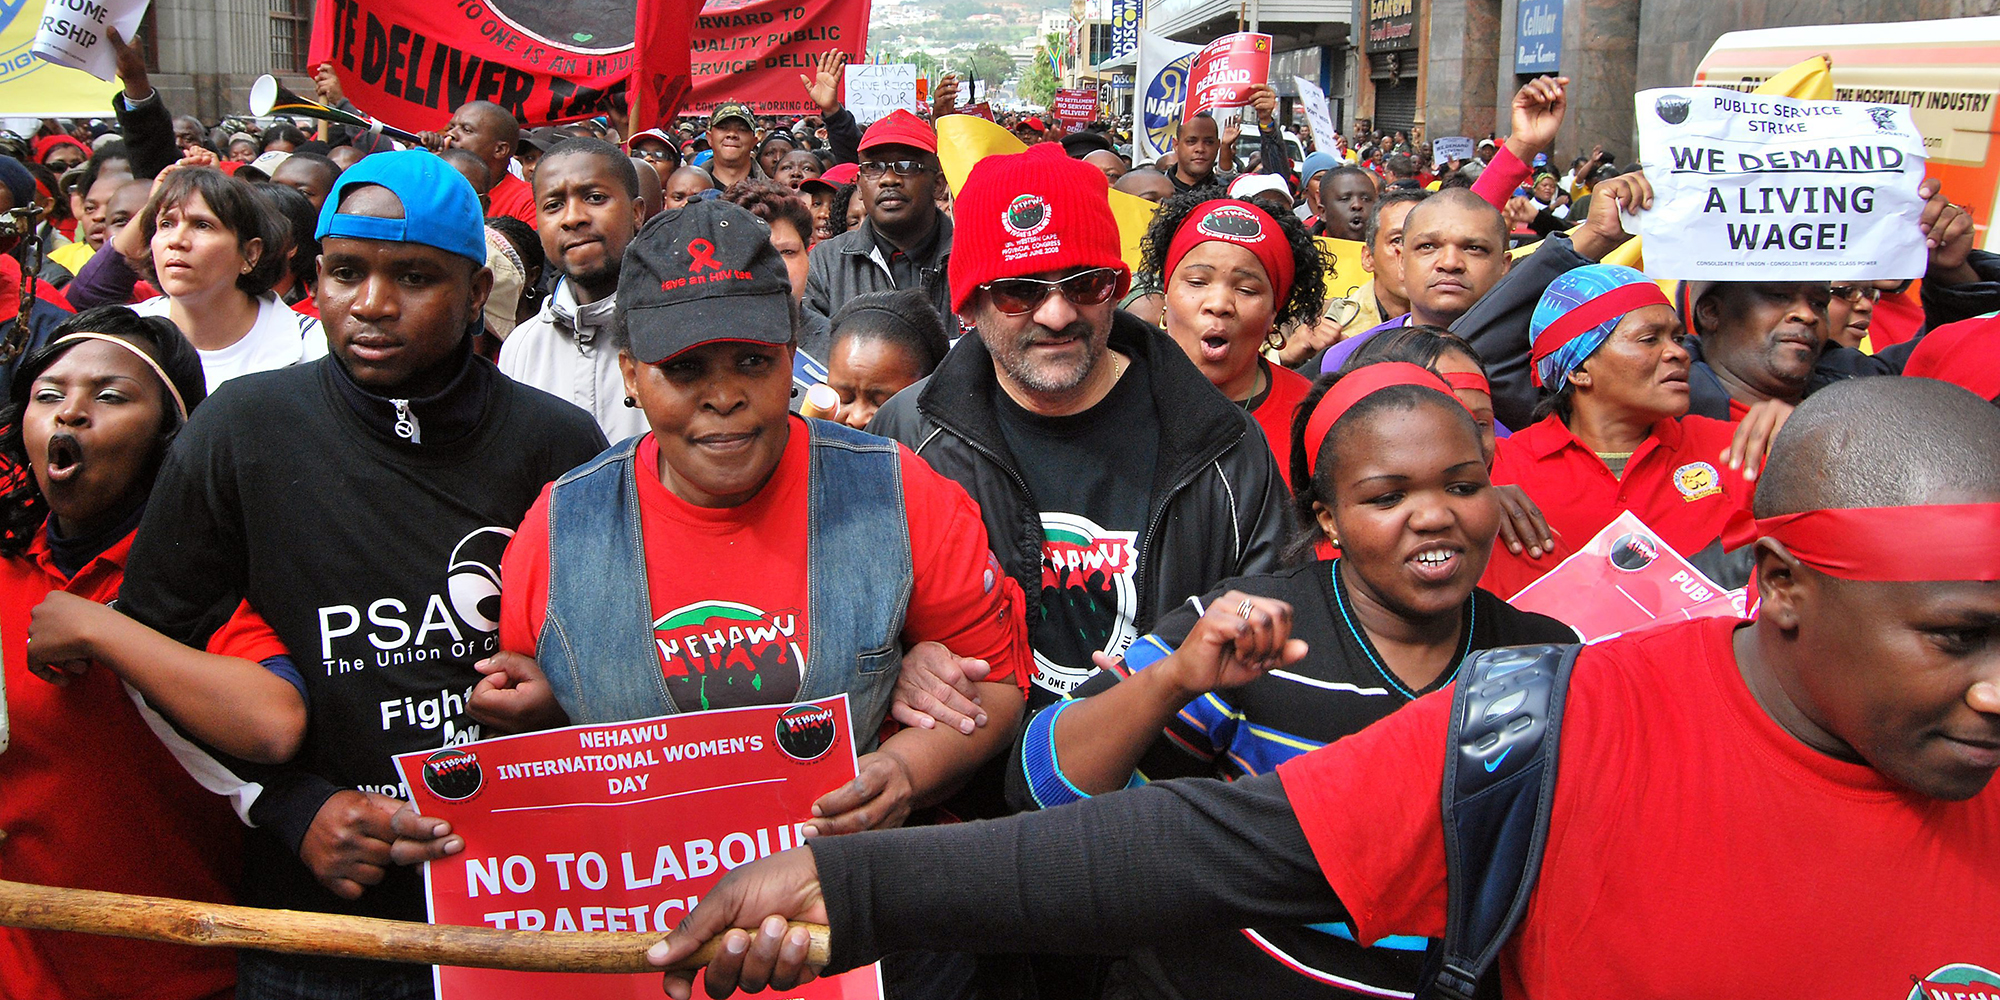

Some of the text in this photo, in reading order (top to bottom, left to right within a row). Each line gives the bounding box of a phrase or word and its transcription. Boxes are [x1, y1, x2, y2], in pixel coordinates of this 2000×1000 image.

[695, 6, 806, 29] RWARD TO
[1523, 4, 1556, 37] Cellular
[41, 15, 97, 49] RSHIP
[690, 25, 841, 53] UALITY PUBLIC
[480, 19, 521, 52] ONE
[522, 44, 545, 65] IS
[548, 55, 577, 75] AN
[361, 11, 535, 124] DELIVER
[857, 66, 909, 77] ZUMA
[1208, 56, 1230, 73] WE
[1196, 69, 1251, 94] DEMAND
[759, 101, 801, 111] WORKING
[852, 91, 911, 106] 2 YOUR
[1199, 87, 1237, 105] 8.5%
[1714, 97, 1843, 119] PUBLIC SERVICE
[1836, 89, 1991, 112] THE HOSPITALITY INDUSTRY
[1748, 121, 1808, 134] STRIKE
[1669, 145, 1904, 172] WE DEMAND
[1703, 186, 1875, 214] A LIVING
[1726, 223, 1849, 250] WAGE!
[689, 275, 706, 285] an
[709, 269, 732, 283] HIV
[318, 594, 463, 660] PSA
[656, 614, 795, 661] NEHAWU
[323, 658, 364, 676] The
[376, 647, 440, 668] Union
[451, 642, 474, 658] Of
[1047, 677, 1067, 690] ONE
[579, 724, 668, 749] NEHAWU
[497, 750, 660, 780] INTERNATIONAL
[663, 735, 764, 763] WOMEN'S
[608, 774, 650, 795] DAY
[465, 855, 537, 898] NO
[546, 851, 608, 891] TO
